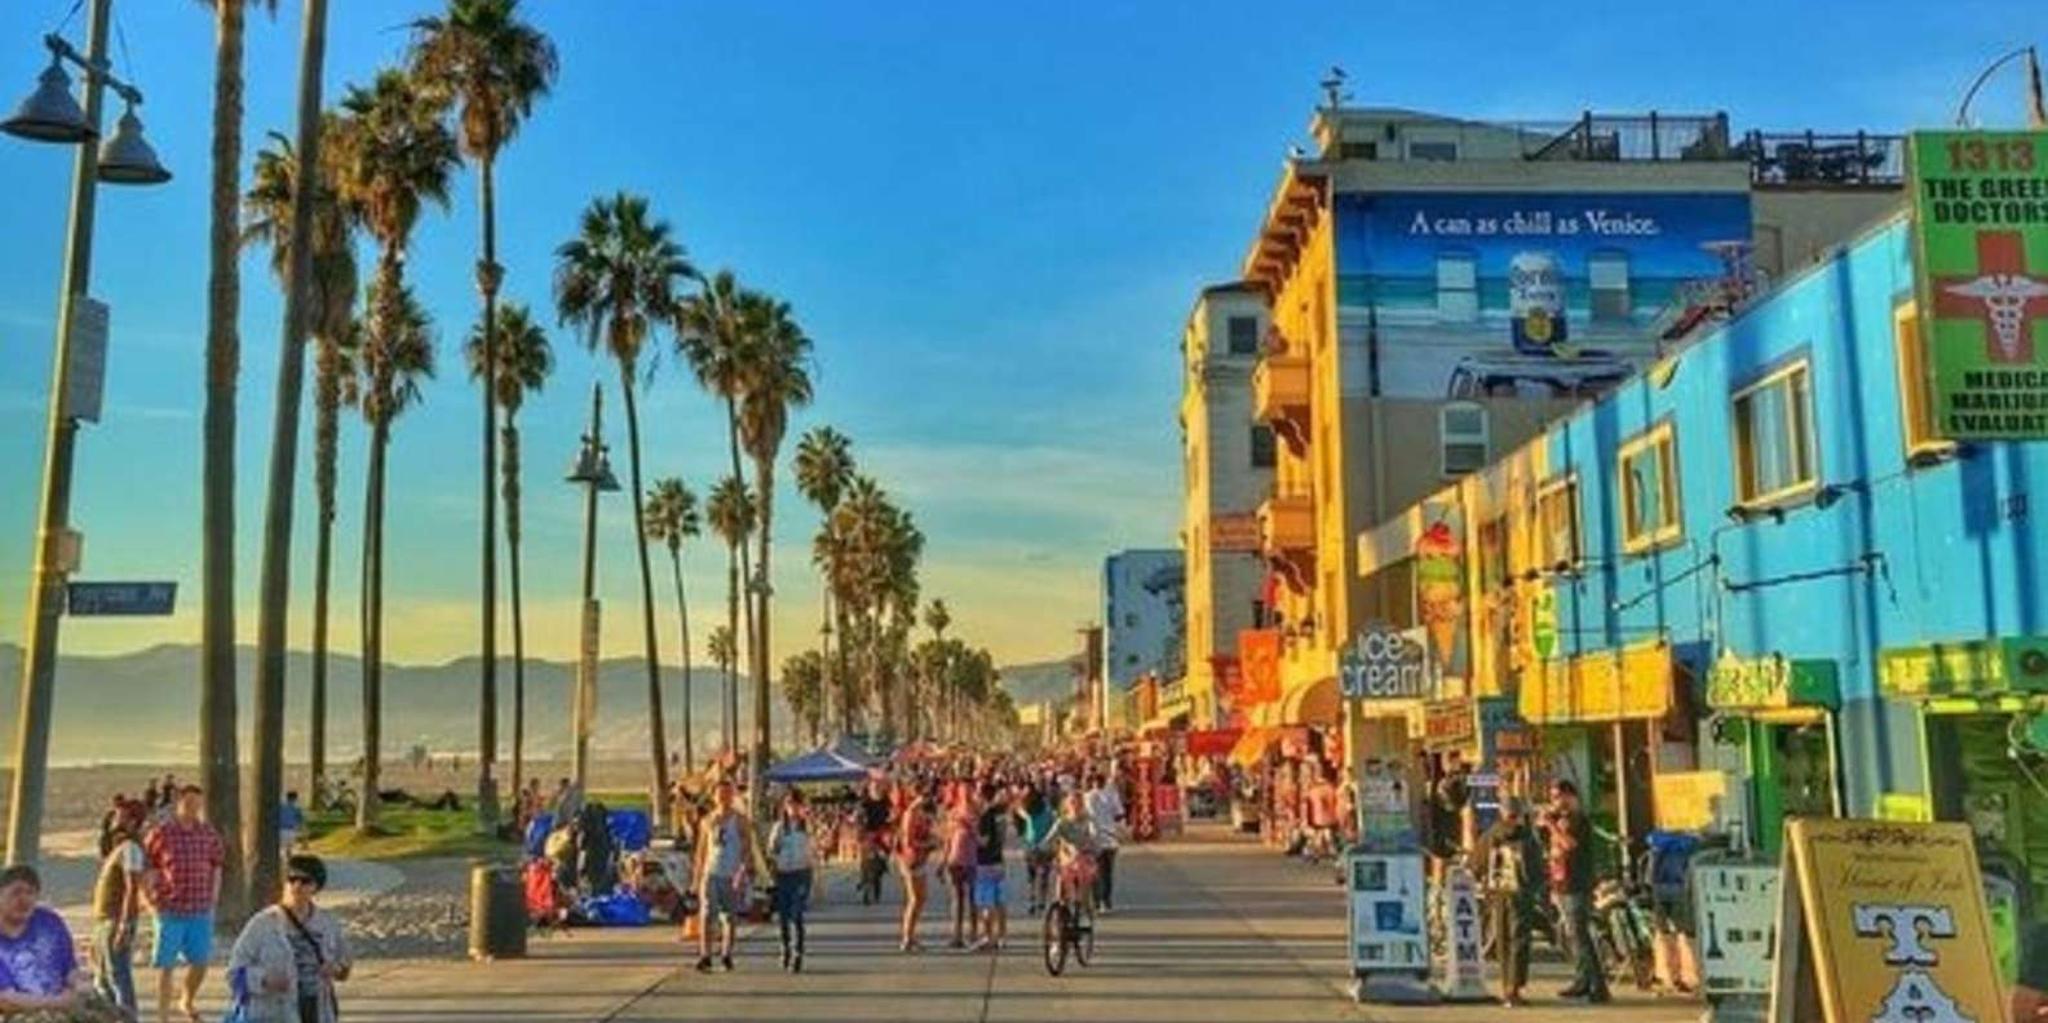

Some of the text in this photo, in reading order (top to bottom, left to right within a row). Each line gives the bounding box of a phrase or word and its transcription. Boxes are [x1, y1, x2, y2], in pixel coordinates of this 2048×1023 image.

[1947, 139, 2033, 172] 1313
[1922, 178, 2048, 199] THE GREE
[1410, 211, 1429, 234] A
[1434, 217, 1471, 235] can
[1476, 217, 1497, 235] as
[1503, 211, 1551, 235] chill
[1557, 217, 1579, 235] as
[1341, 664, 1431, 695] cream
[1456, 897, 1478, 961] ATM
